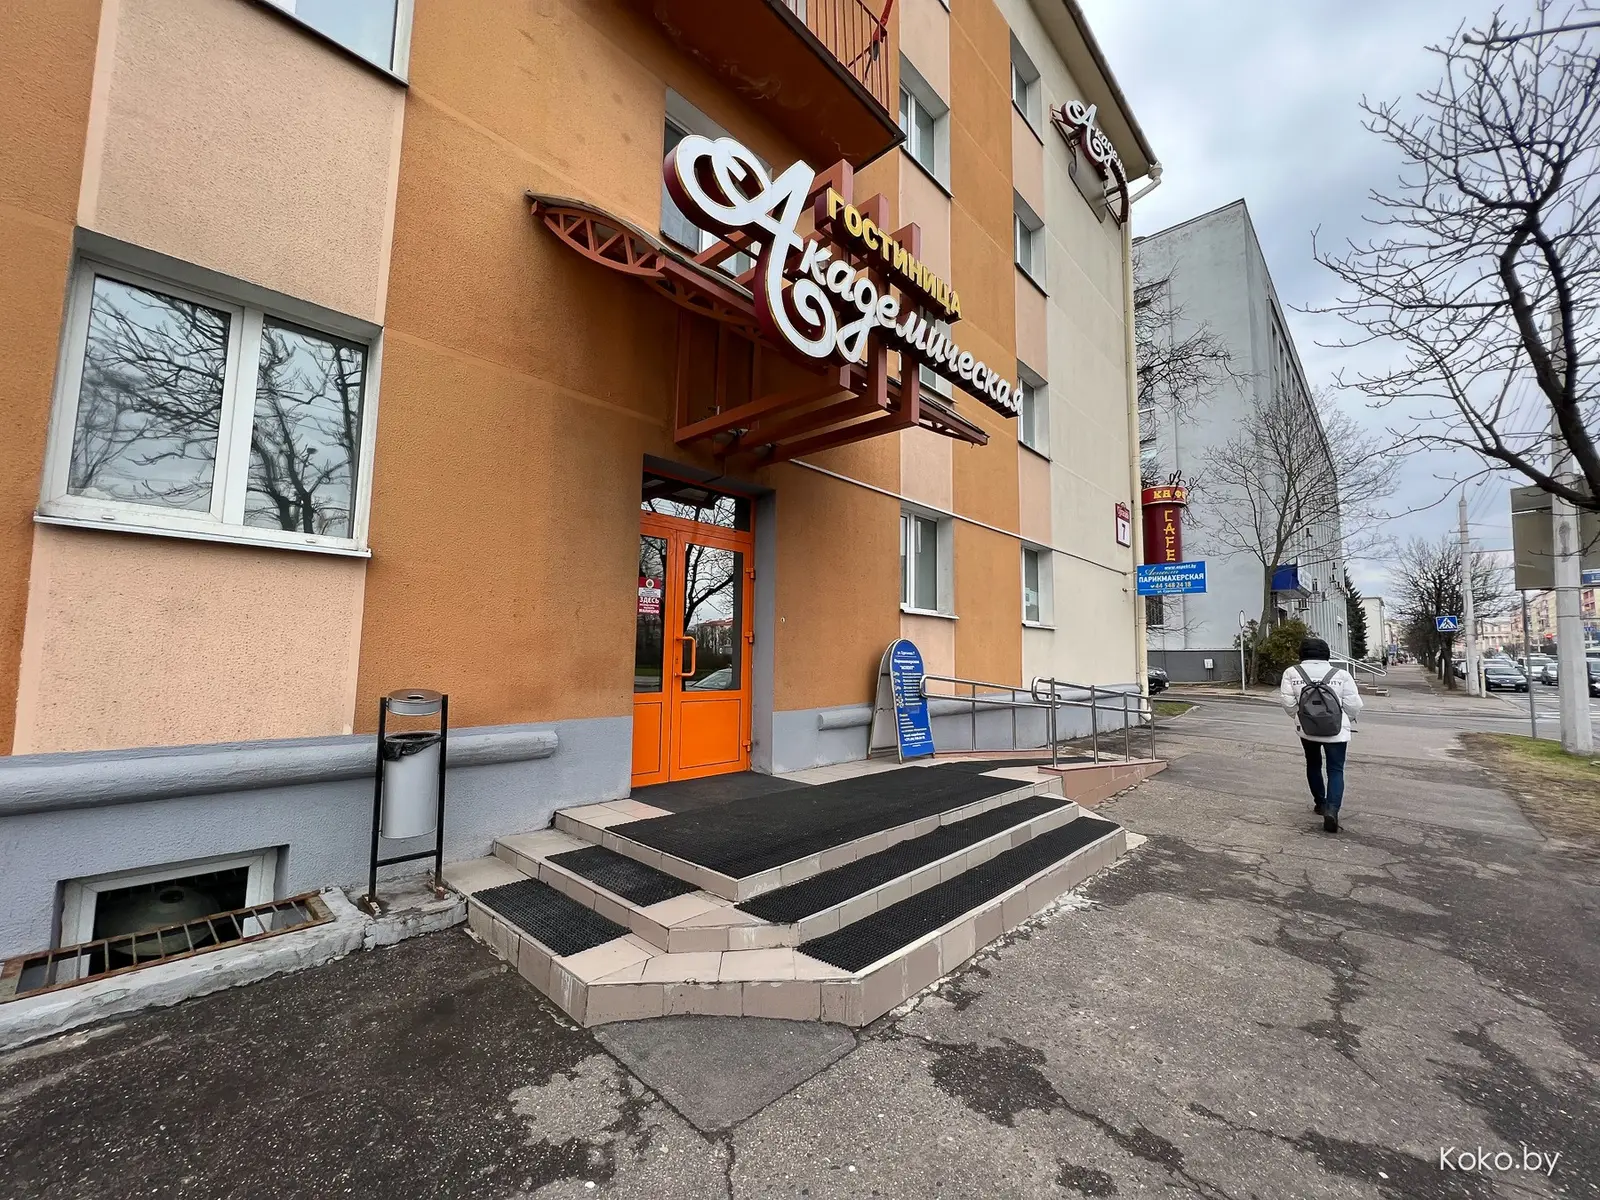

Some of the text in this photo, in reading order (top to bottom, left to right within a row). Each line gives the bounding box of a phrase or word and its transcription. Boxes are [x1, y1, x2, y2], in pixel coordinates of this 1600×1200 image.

[665, 134, 1024, 416] Академическая
[826, 187, 962, 320] ГОСТИНИЦА
[1138, 573, 1204, 583] ПАРИКМАХЕРСКАЯ
